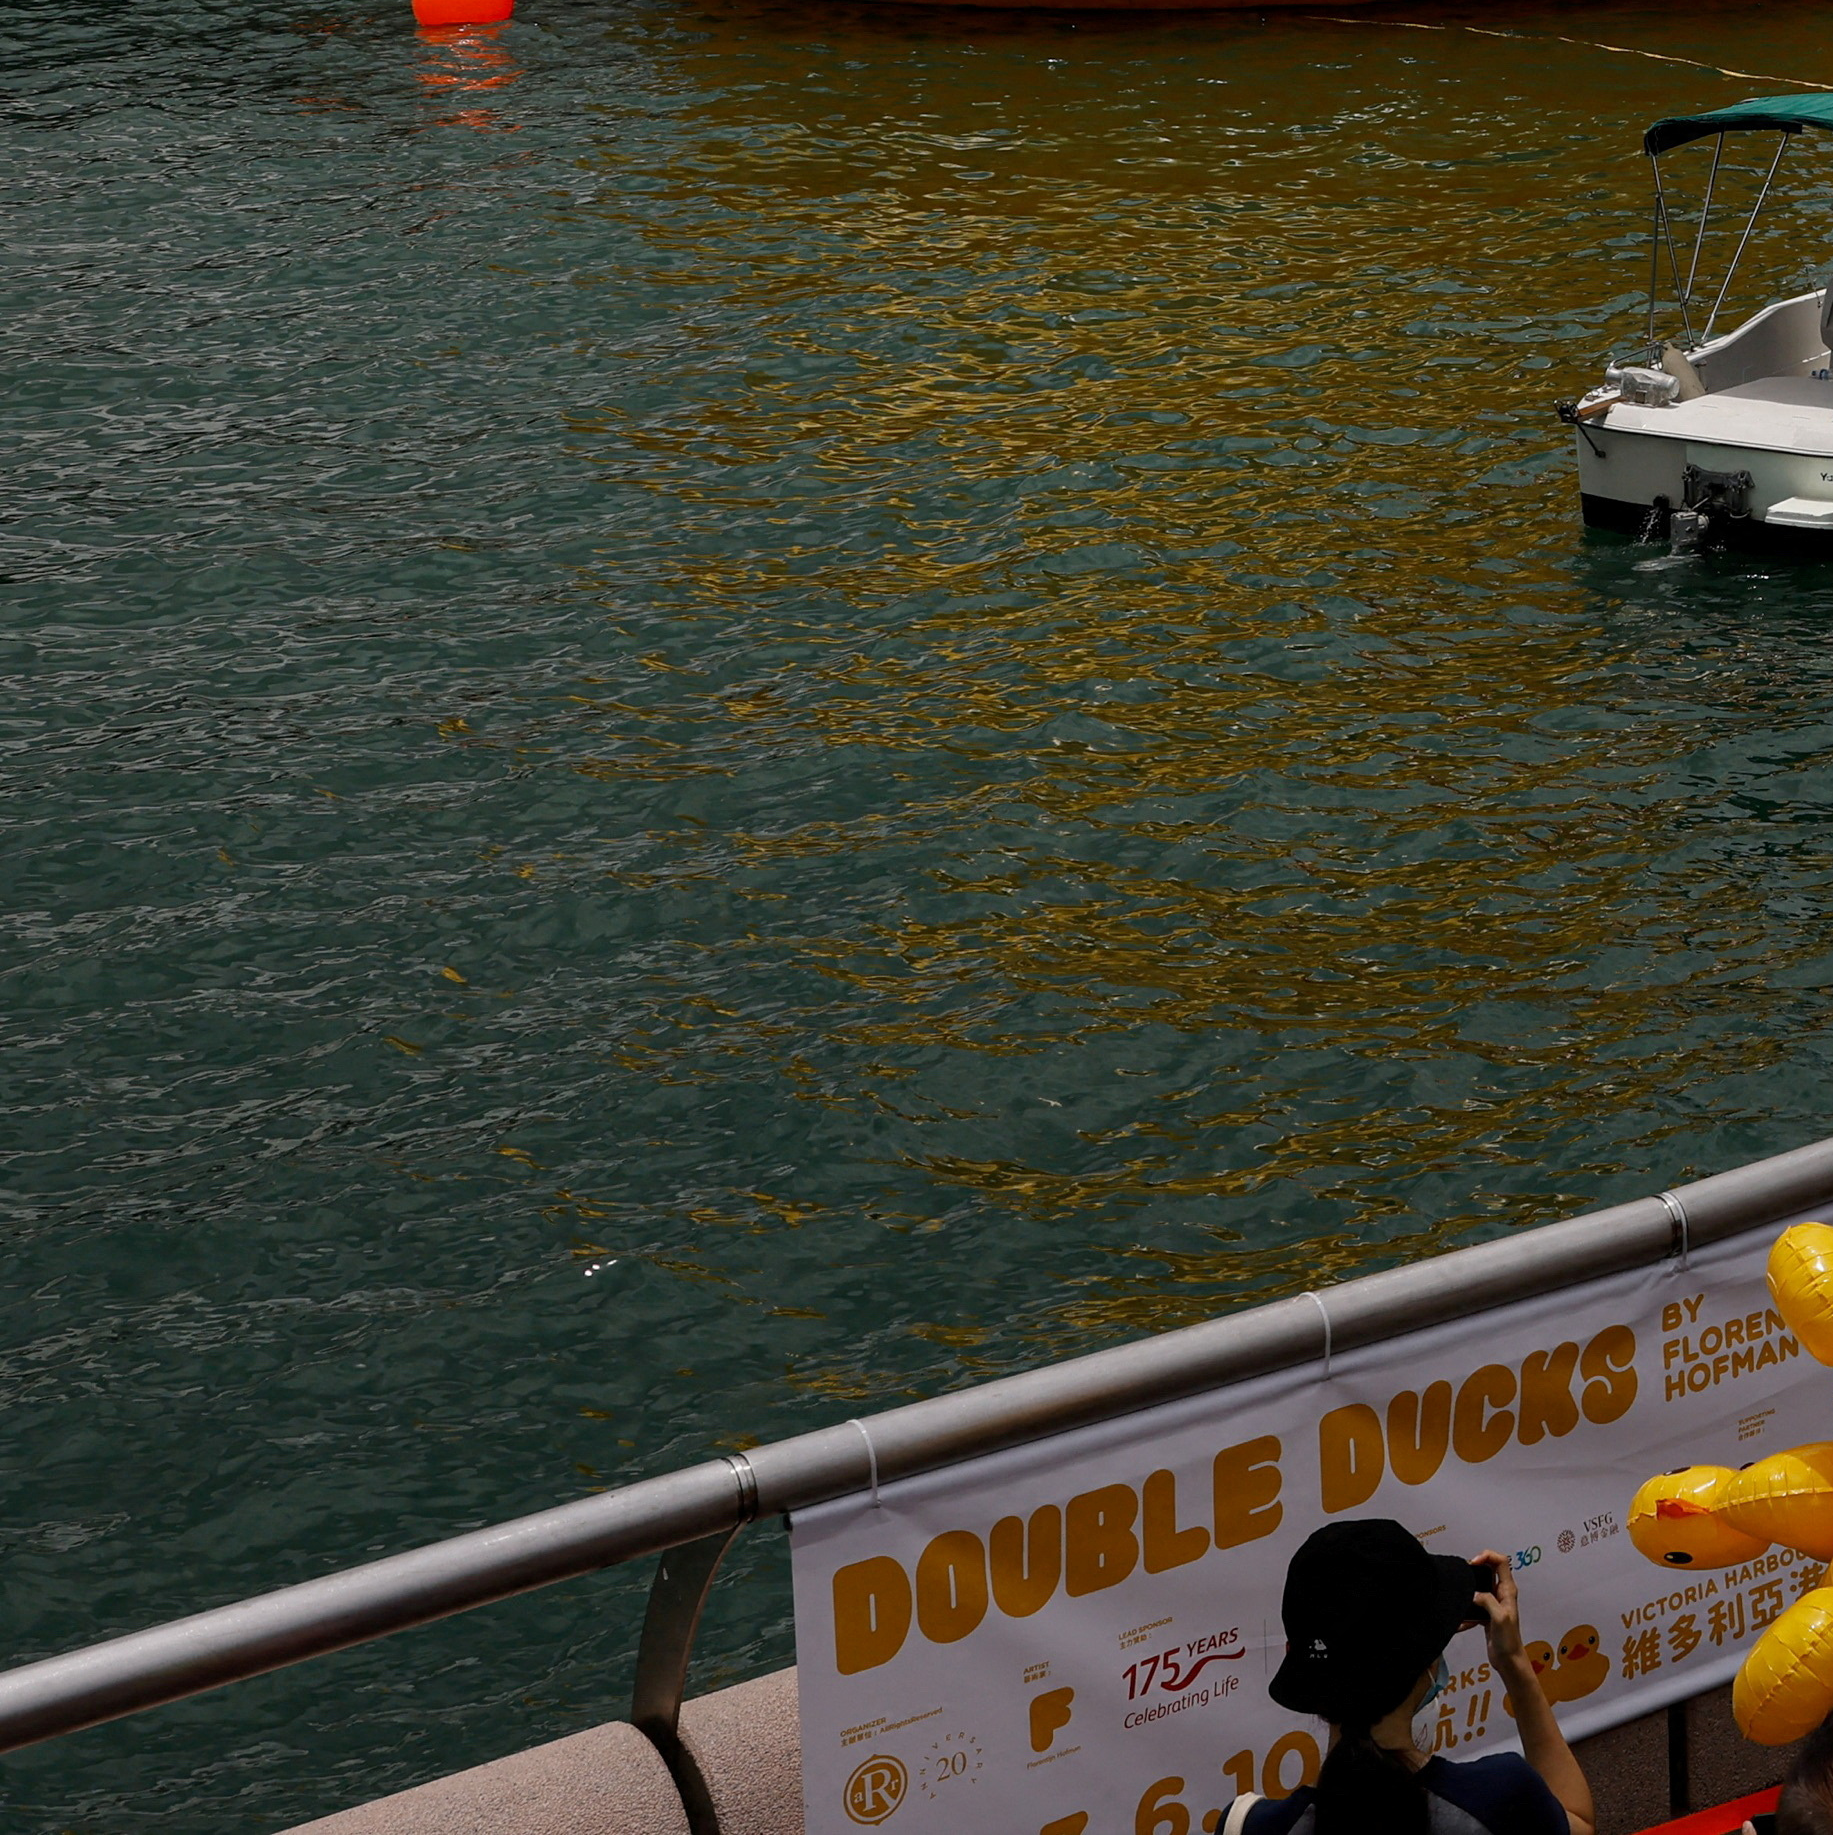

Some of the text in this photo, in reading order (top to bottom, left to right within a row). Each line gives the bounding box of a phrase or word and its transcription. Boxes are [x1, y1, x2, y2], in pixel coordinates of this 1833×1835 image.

[1662, 1293, 1704, 1332] BY
[1663, 1308, 1788, 1370] FLOREN
[1664, 1335, 1800, 1402] HOFMAN
[833, 1324, 1638, 1676] DOUBLE DUCKS
[1414, 1524, 1447, 1539] PONSORS
[1583, 1511, 1613, 1533] VSFG
[1513, 1545, 1542, 1571] 360
[1621, 1548, 1807, 1629] VICTORIA HARBOU
[1118, 1616, 1173, 1641] LEAD SPONSOR
[1186, 1627, 1240, 1658] YEARS
[1023, 1660, 1049, 1675] ARTIST
[1122, 1647, 1182, 1701] 175
[1124, 1675, 1240, 1729] Celebrating Life
[840, 1717, 887, 1737] ORGANIZER
[936, 1751, 968, 1783] 20
